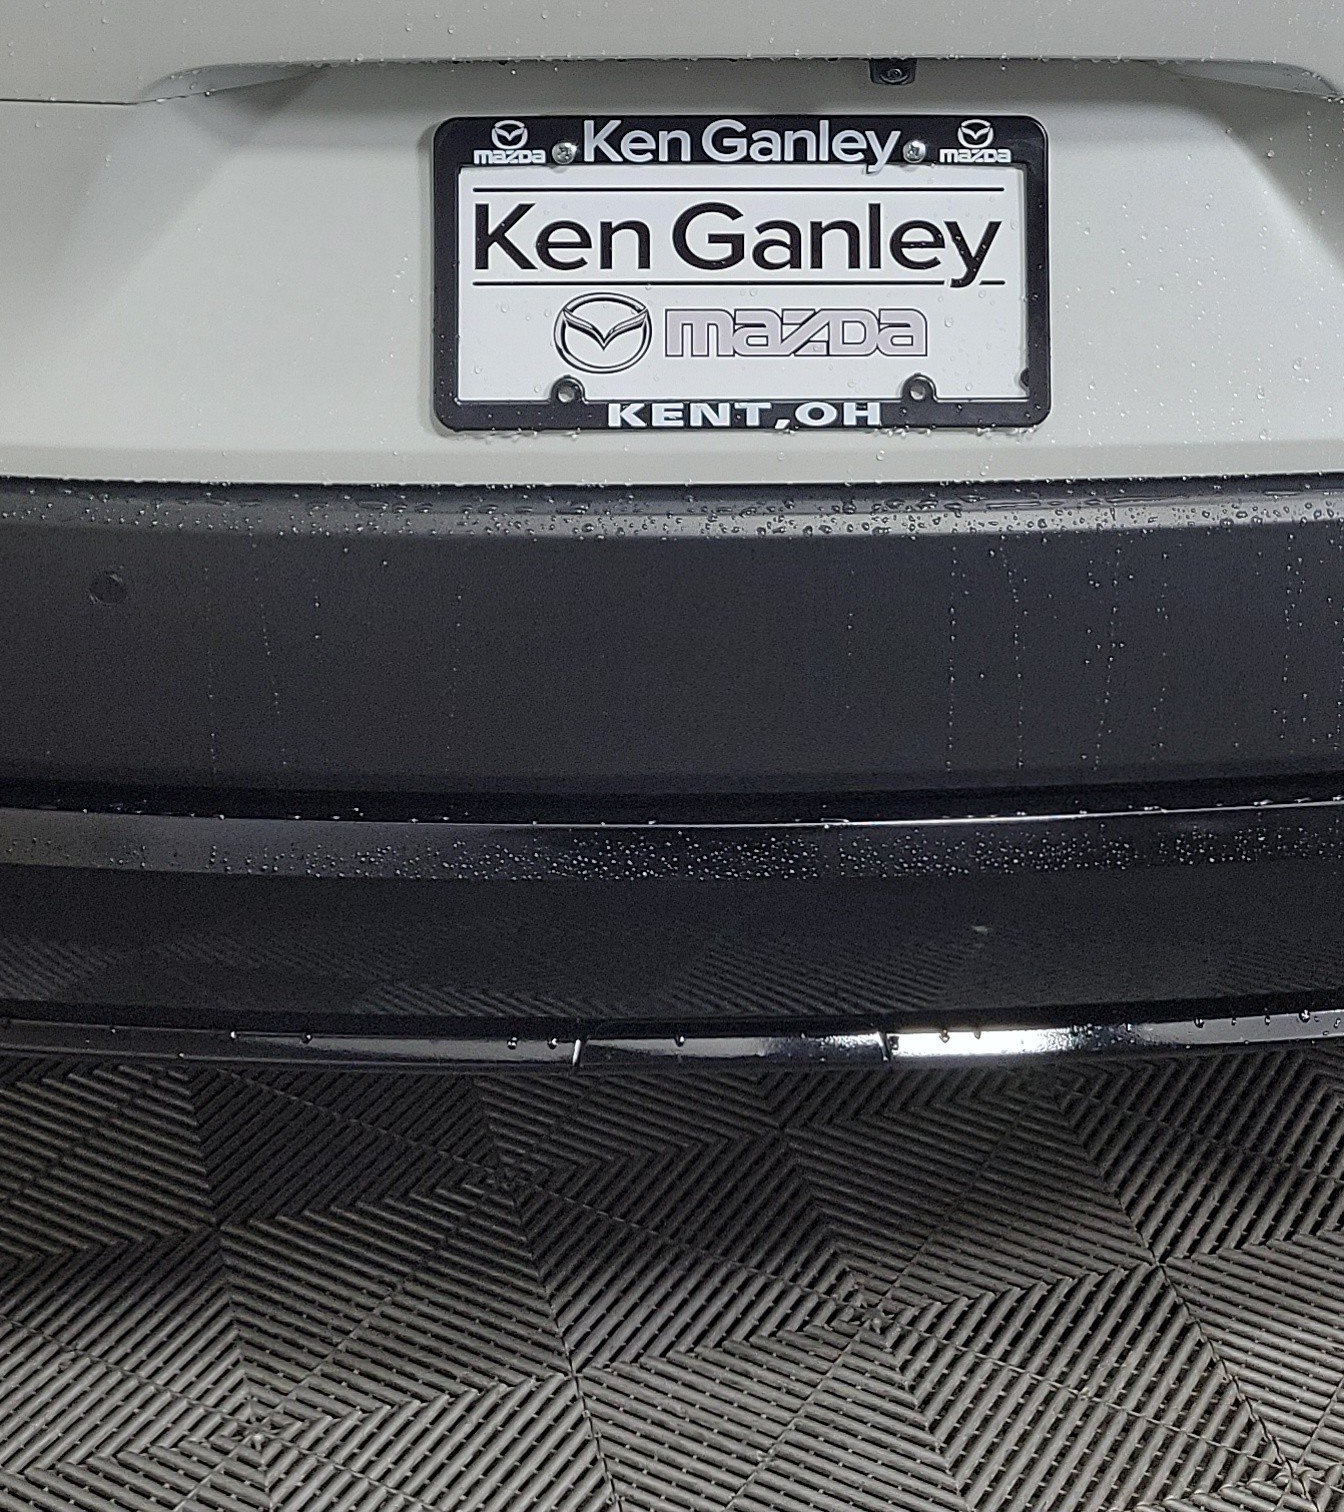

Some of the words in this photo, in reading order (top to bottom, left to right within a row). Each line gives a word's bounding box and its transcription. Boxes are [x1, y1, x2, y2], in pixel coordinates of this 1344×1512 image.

[583, 119, 692, 163] Ken
[701, 119, 902, 174] Ganley
[474, 203, 651, 271] Ken
[672, 202, 1003, 288] Ganley
